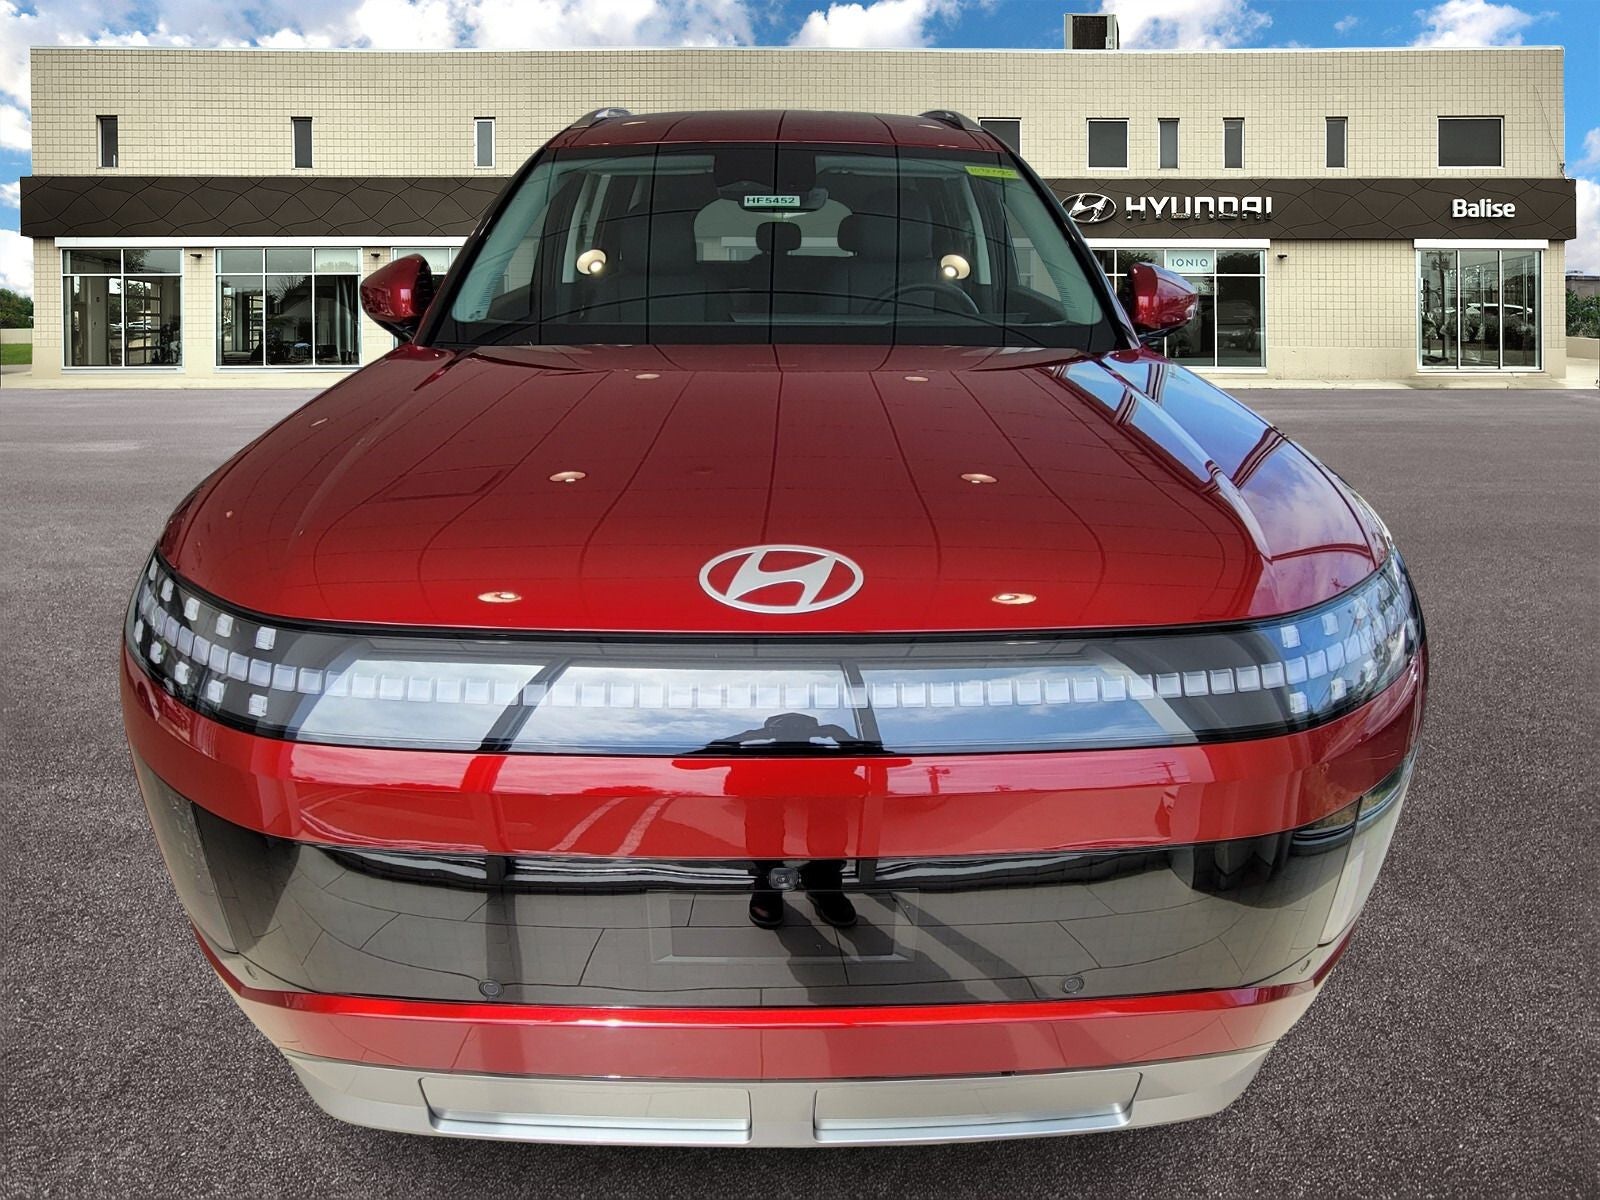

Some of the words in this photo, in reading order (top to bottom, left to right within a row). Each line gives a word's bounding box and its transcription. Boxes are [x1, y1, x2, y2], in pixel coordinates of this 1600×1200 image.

[746, 196, 796, 204] HF5452
[1125, 196, 1273, 220] HYUNDAI
[1452, 198, 1516, 218] Balise
[1171, 258, 1209, 267] IONIQ
